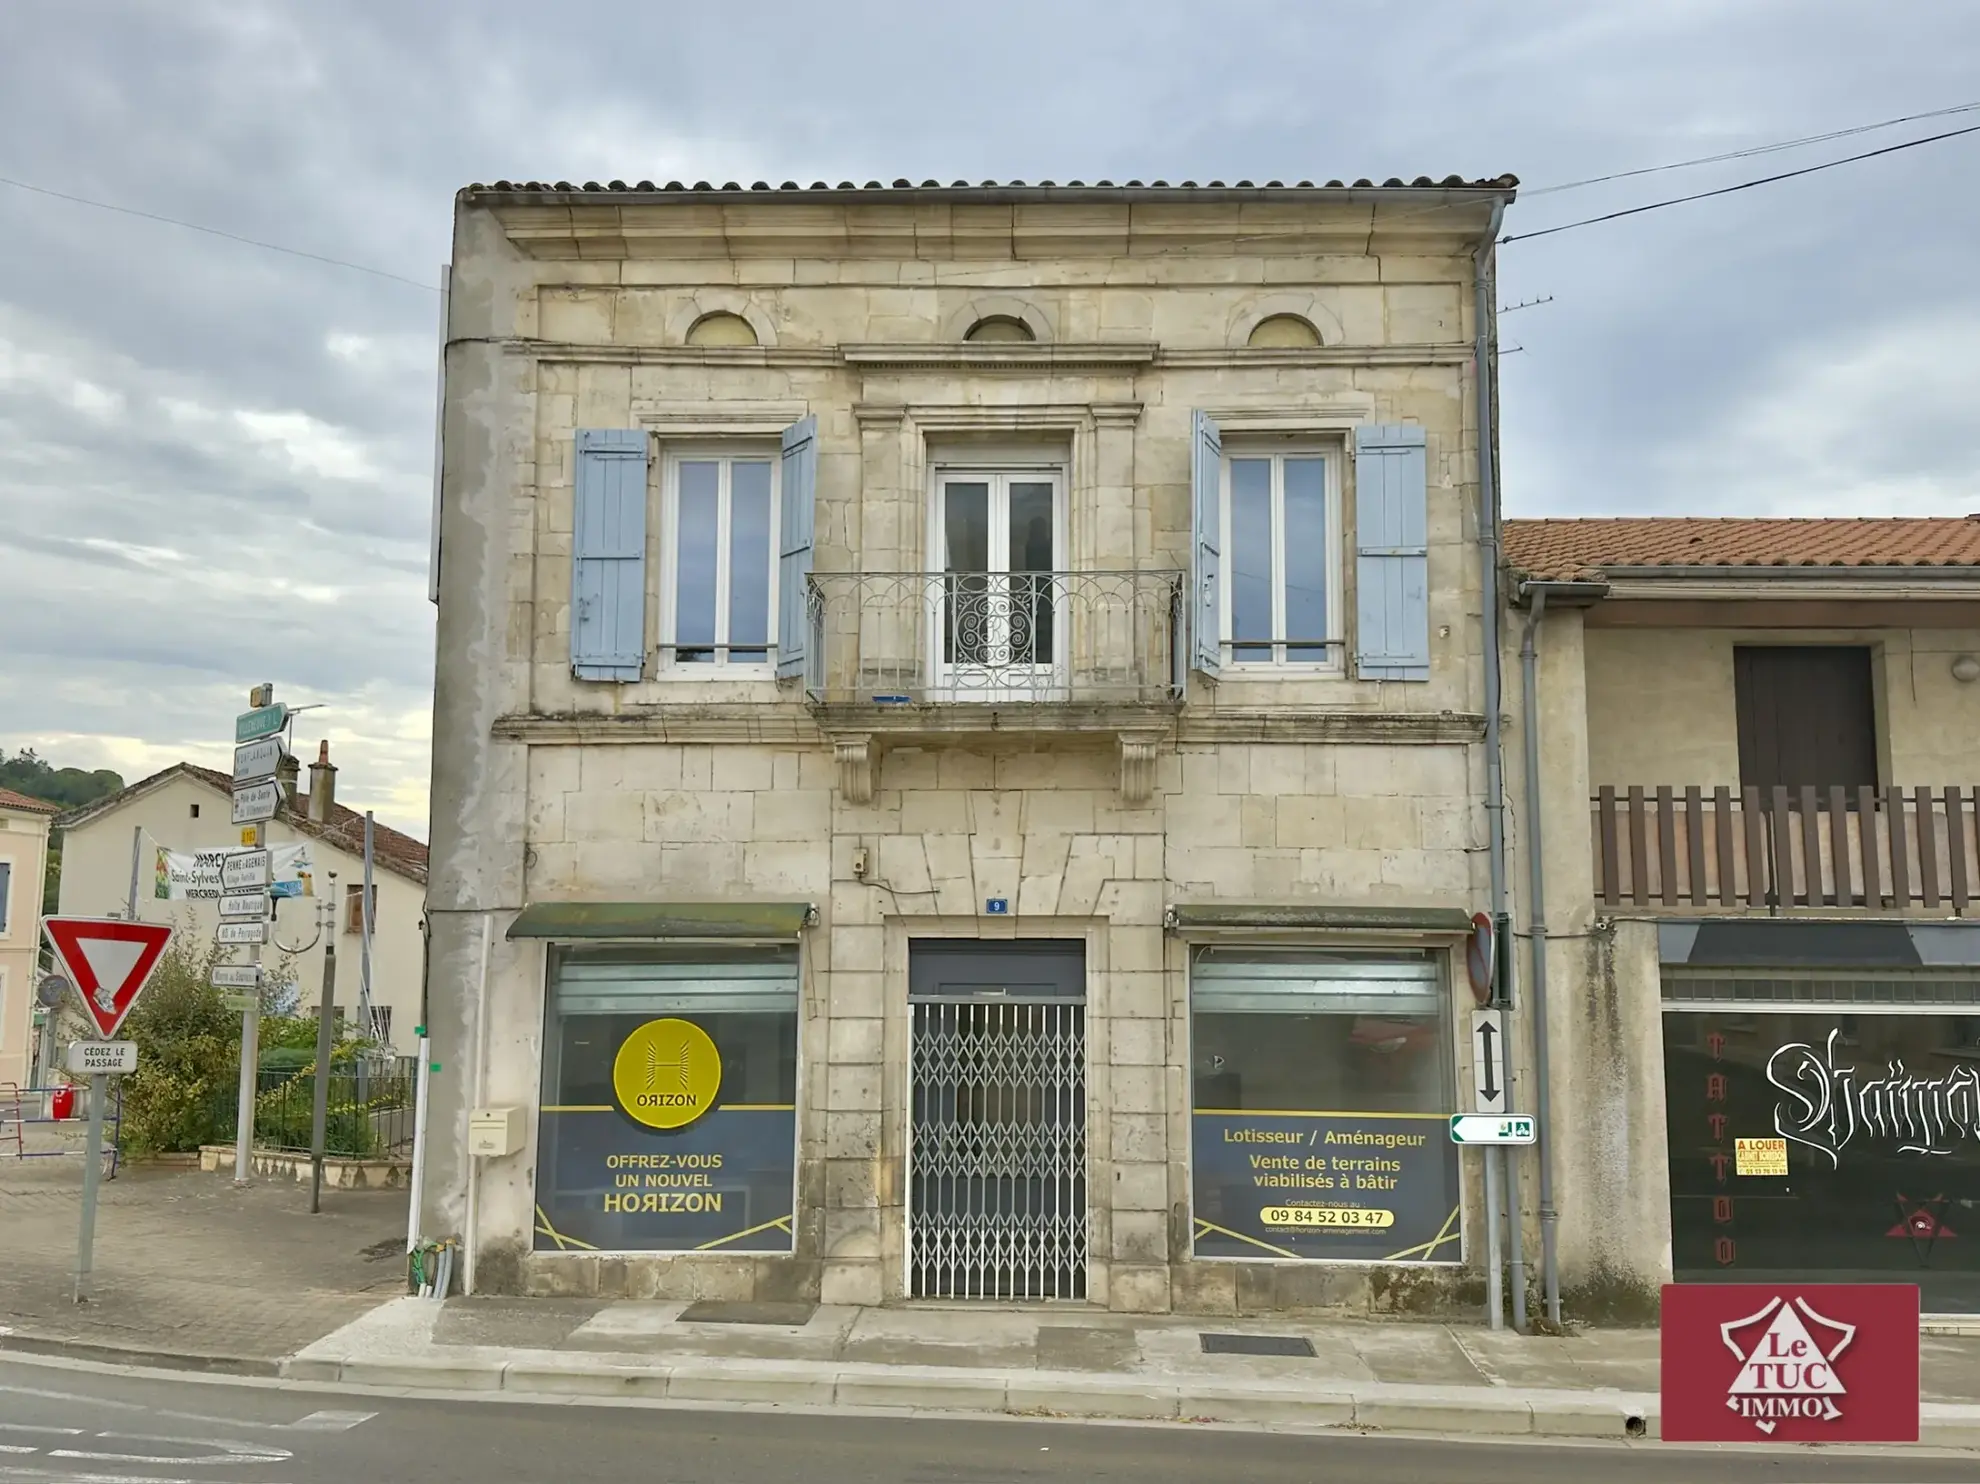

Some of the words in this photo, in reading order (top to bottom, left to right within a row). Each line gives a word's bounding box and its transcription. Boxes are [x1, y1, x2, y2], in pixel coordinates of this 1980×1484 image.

[227, 859, 242, 872] PENNE
[171, 869, 220, 887] Saint-Sylves
[994, 901, 1000, 911] 9
[84, 1046, 111, 1056] CÉDEZ
[115, 1047, 125, 1056] LE
[84, 1058, 123, 1067] PASSAGE
[1224, 1128, 1304, 1144] Lotisseur
[1324, 1130, 1426, 1149] Aménageur
[1738, 1140, 1746, 1150] A
[1749, 1140, 1785, 1150] LOUER
[606, 1154, 723, 1169] OFFREZ-VOUS
[1249, 1154, 1300, 1170] Vente
[1304, 1155, 1326, 1170] de
[1332, 1156, 1401, 1172] terrains
[615, 1174, 639, 1188] UN
[645, 1174, 713, 1188] NOUVEL
[1253, 1172, 1334, 1189] viabilisés
[1339, 1174, 1350, 1189] à
[1356, 1174, 1399, 1190] bâtir
[1285, 1199, 1348, 1208] Contactez-nous
[1271, 1210, 1289, 1221] 09
[1294, 1210, 1313, 1222] 84
[1318, 1211, 1336, 1223] 52
[1341, 1211, 1360, 1223] 03
[1365, 1212, 1384, 1224] 47
